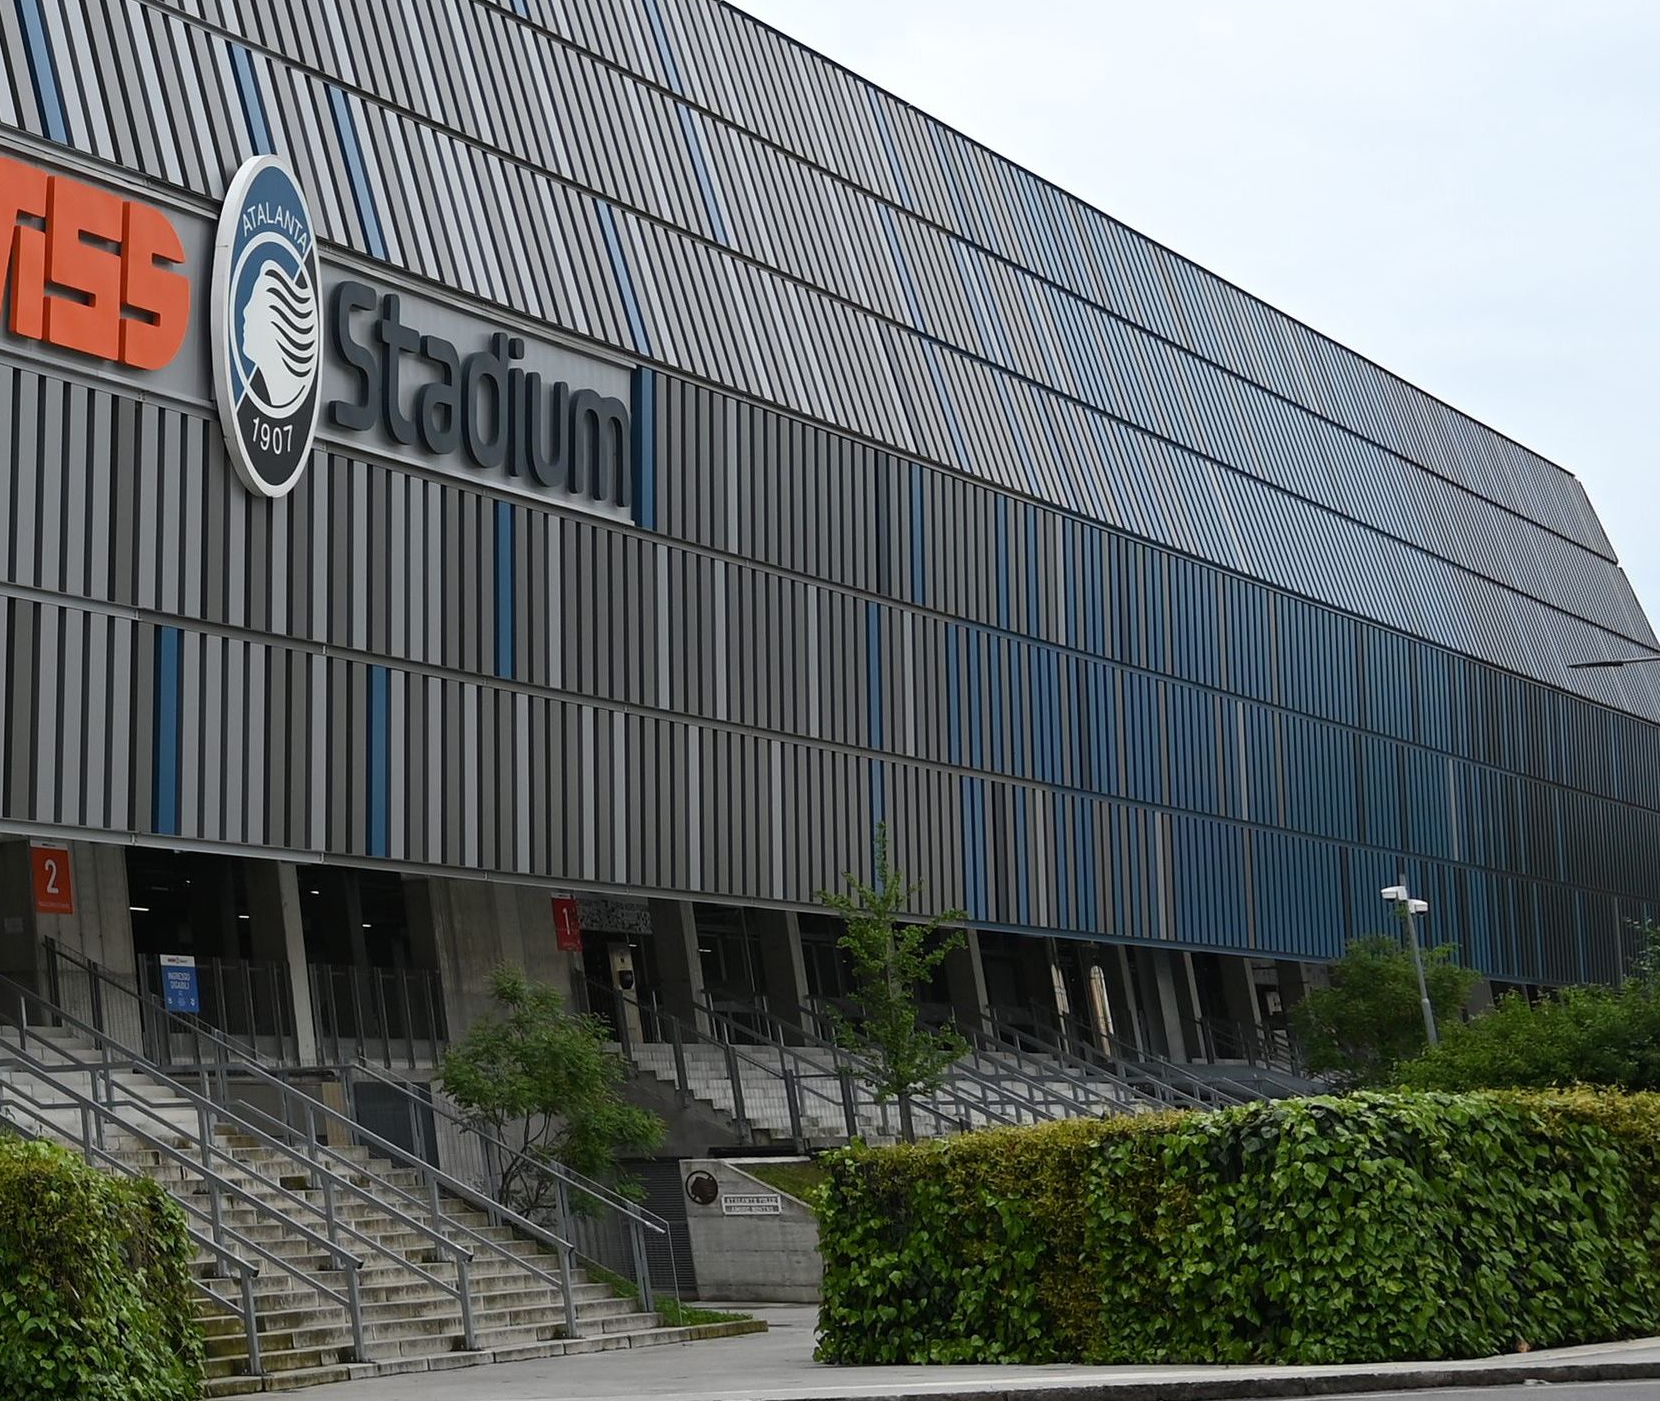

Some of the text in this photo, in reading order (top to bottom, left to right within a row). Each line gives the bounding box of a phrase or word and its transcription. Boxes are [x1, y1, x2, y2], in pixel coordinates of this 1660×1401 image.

[242, 201, 308, 253] ATALANTA
[328, 280, 631, 508] Stadium
[252, 417, 293, 455] 1907
[44, 858, 59, 894] 2
[562, 907, 571, 936] 1
